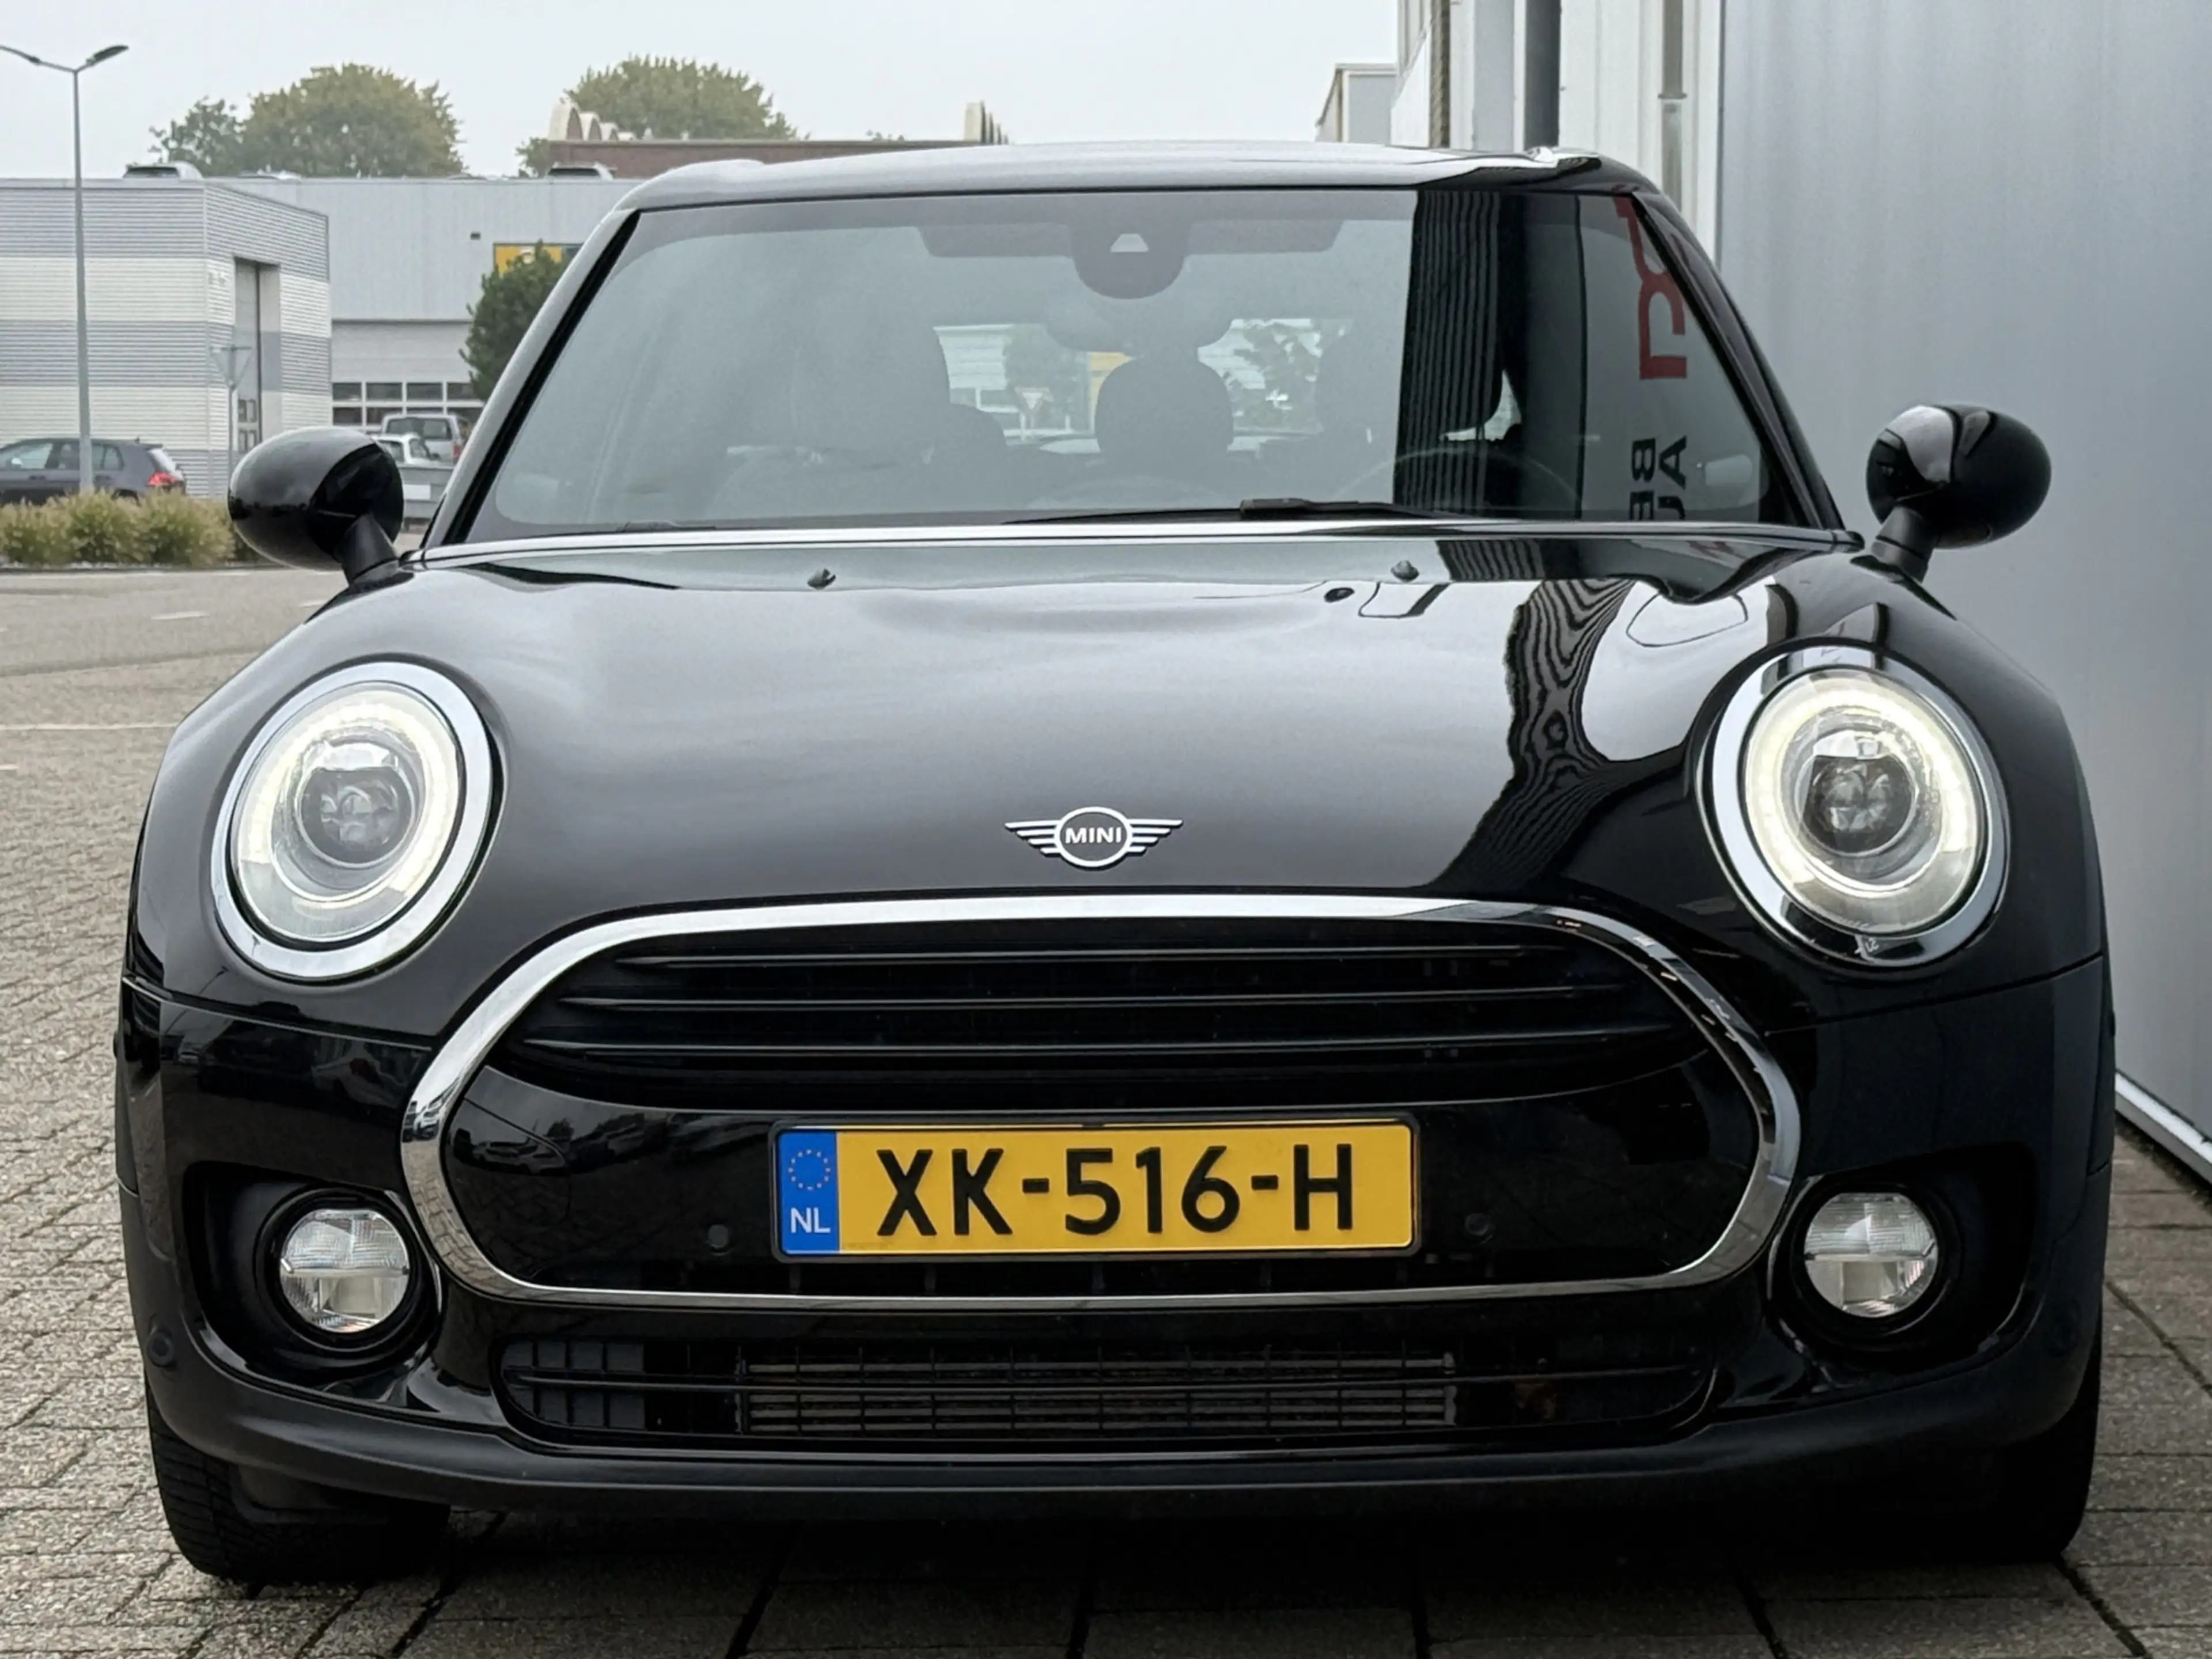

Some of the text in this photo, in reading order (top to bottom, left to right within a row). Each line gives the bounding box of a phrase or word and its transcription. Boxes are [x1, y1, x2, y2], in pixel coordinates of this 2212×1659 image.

[1065, 827, 1122, 844] MINI
[877, 1143, 1353, 1237] XK-516-H
[790, 1207, 831, 1233] NL
